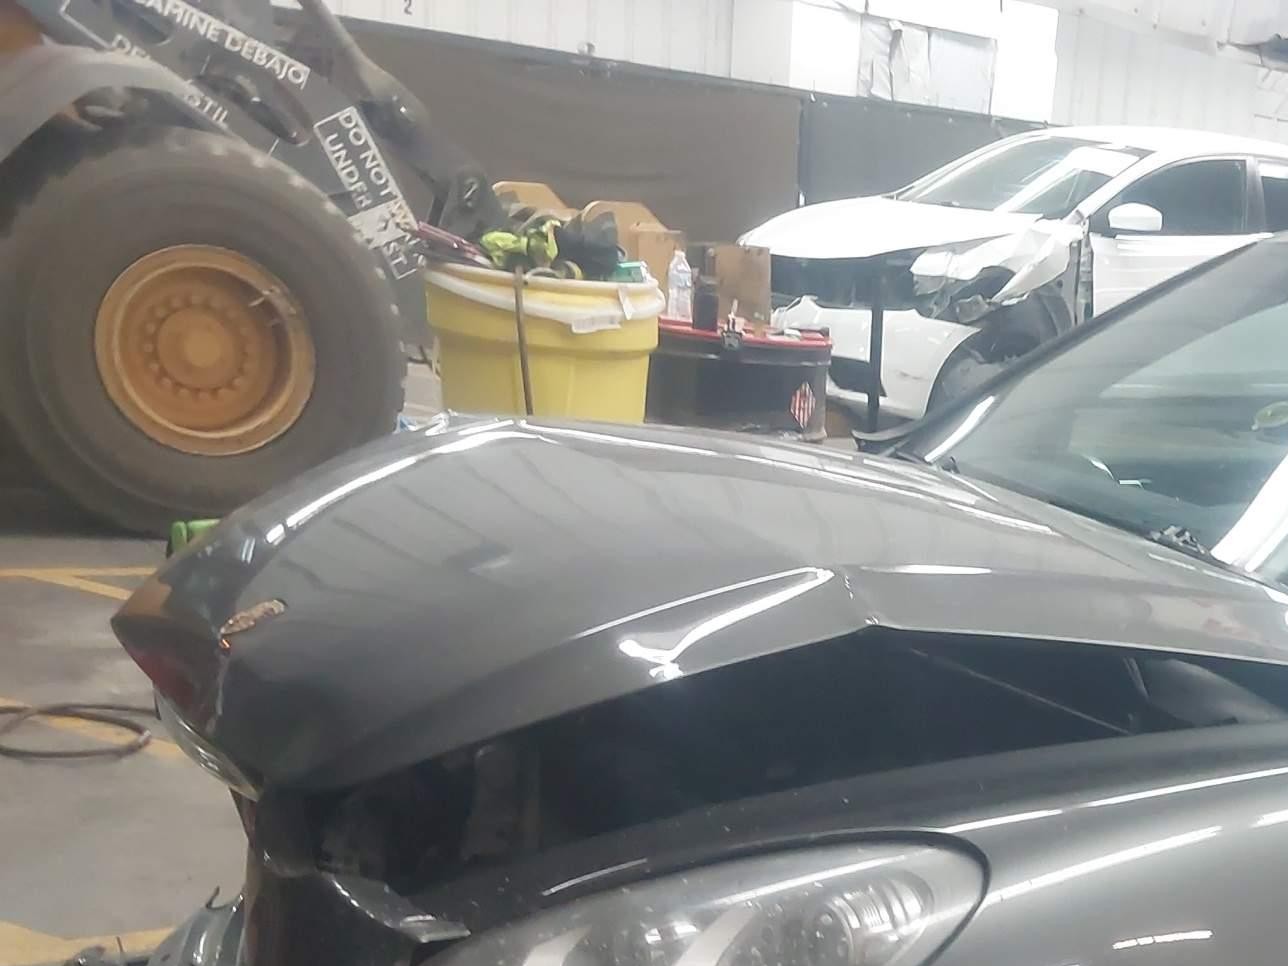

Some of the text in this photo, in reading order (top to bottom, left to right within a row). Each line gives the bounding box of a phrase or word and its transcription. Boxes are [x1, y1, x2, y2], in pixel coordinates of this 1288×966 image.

[136, 0, 305, 84] AMINE DEBAJO
[325, 133, 372, 208] UNDER
[338, 113, 399, 197] DO NOT
